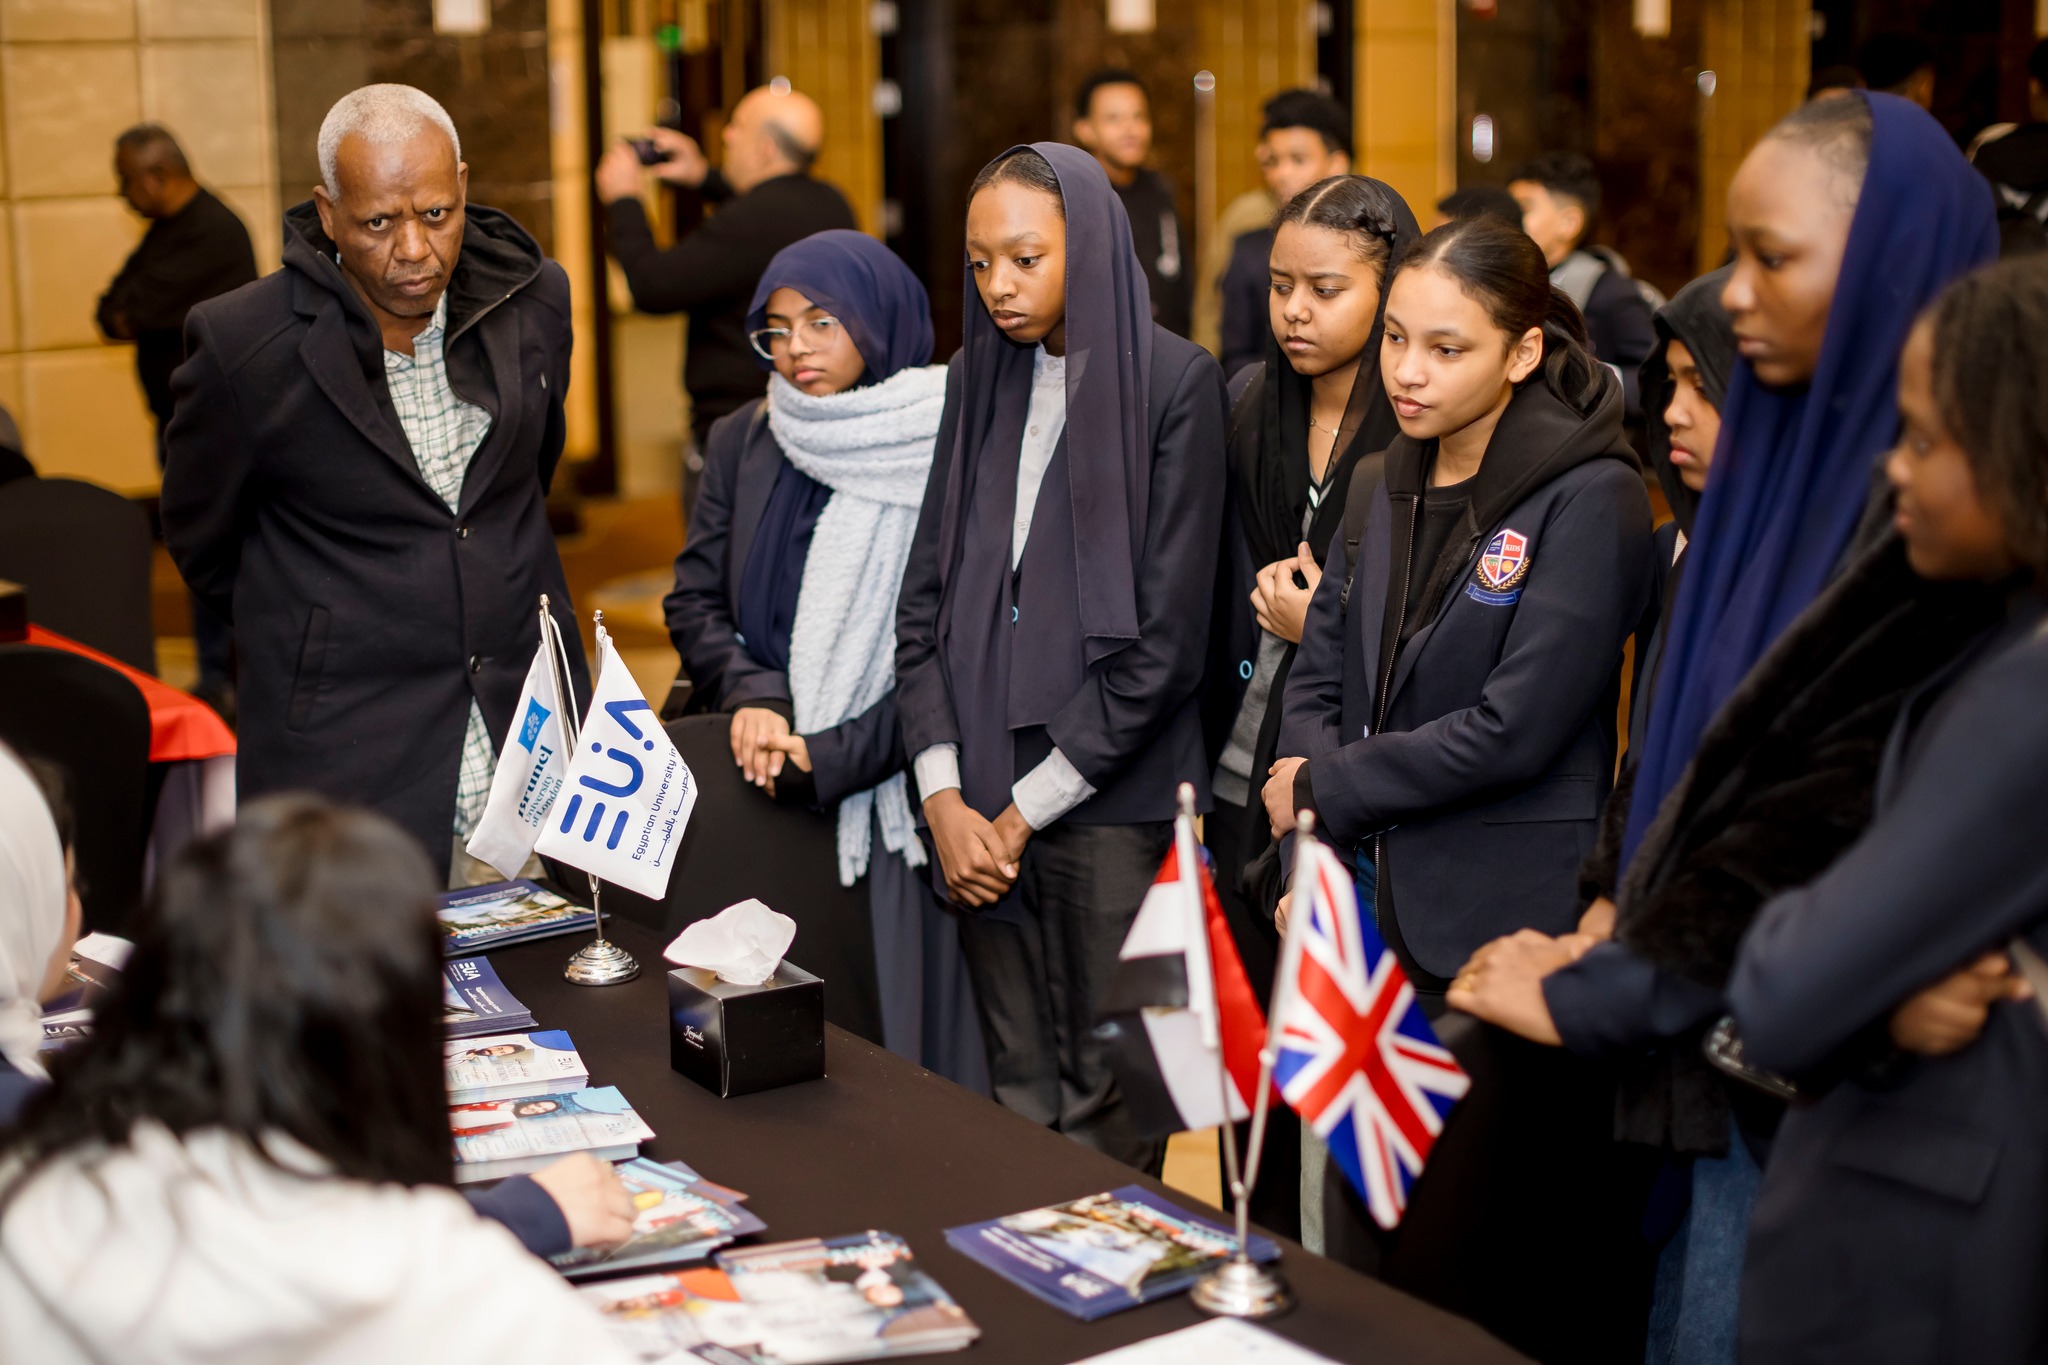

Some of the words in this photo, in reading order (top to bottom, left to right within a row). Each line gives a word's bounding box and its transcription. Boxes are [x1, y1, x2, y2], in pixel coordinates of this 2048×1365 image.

[1505, 544, 1521, 552] KIDS
[525, 773, 555, 823] University
[532, 815, 540, 828] of
[537, 779, 563, 816] London
[632, 814, 657, 860] Egyptian
[651, 759, 677, 812] University
[668, 748, 676, 758] in
